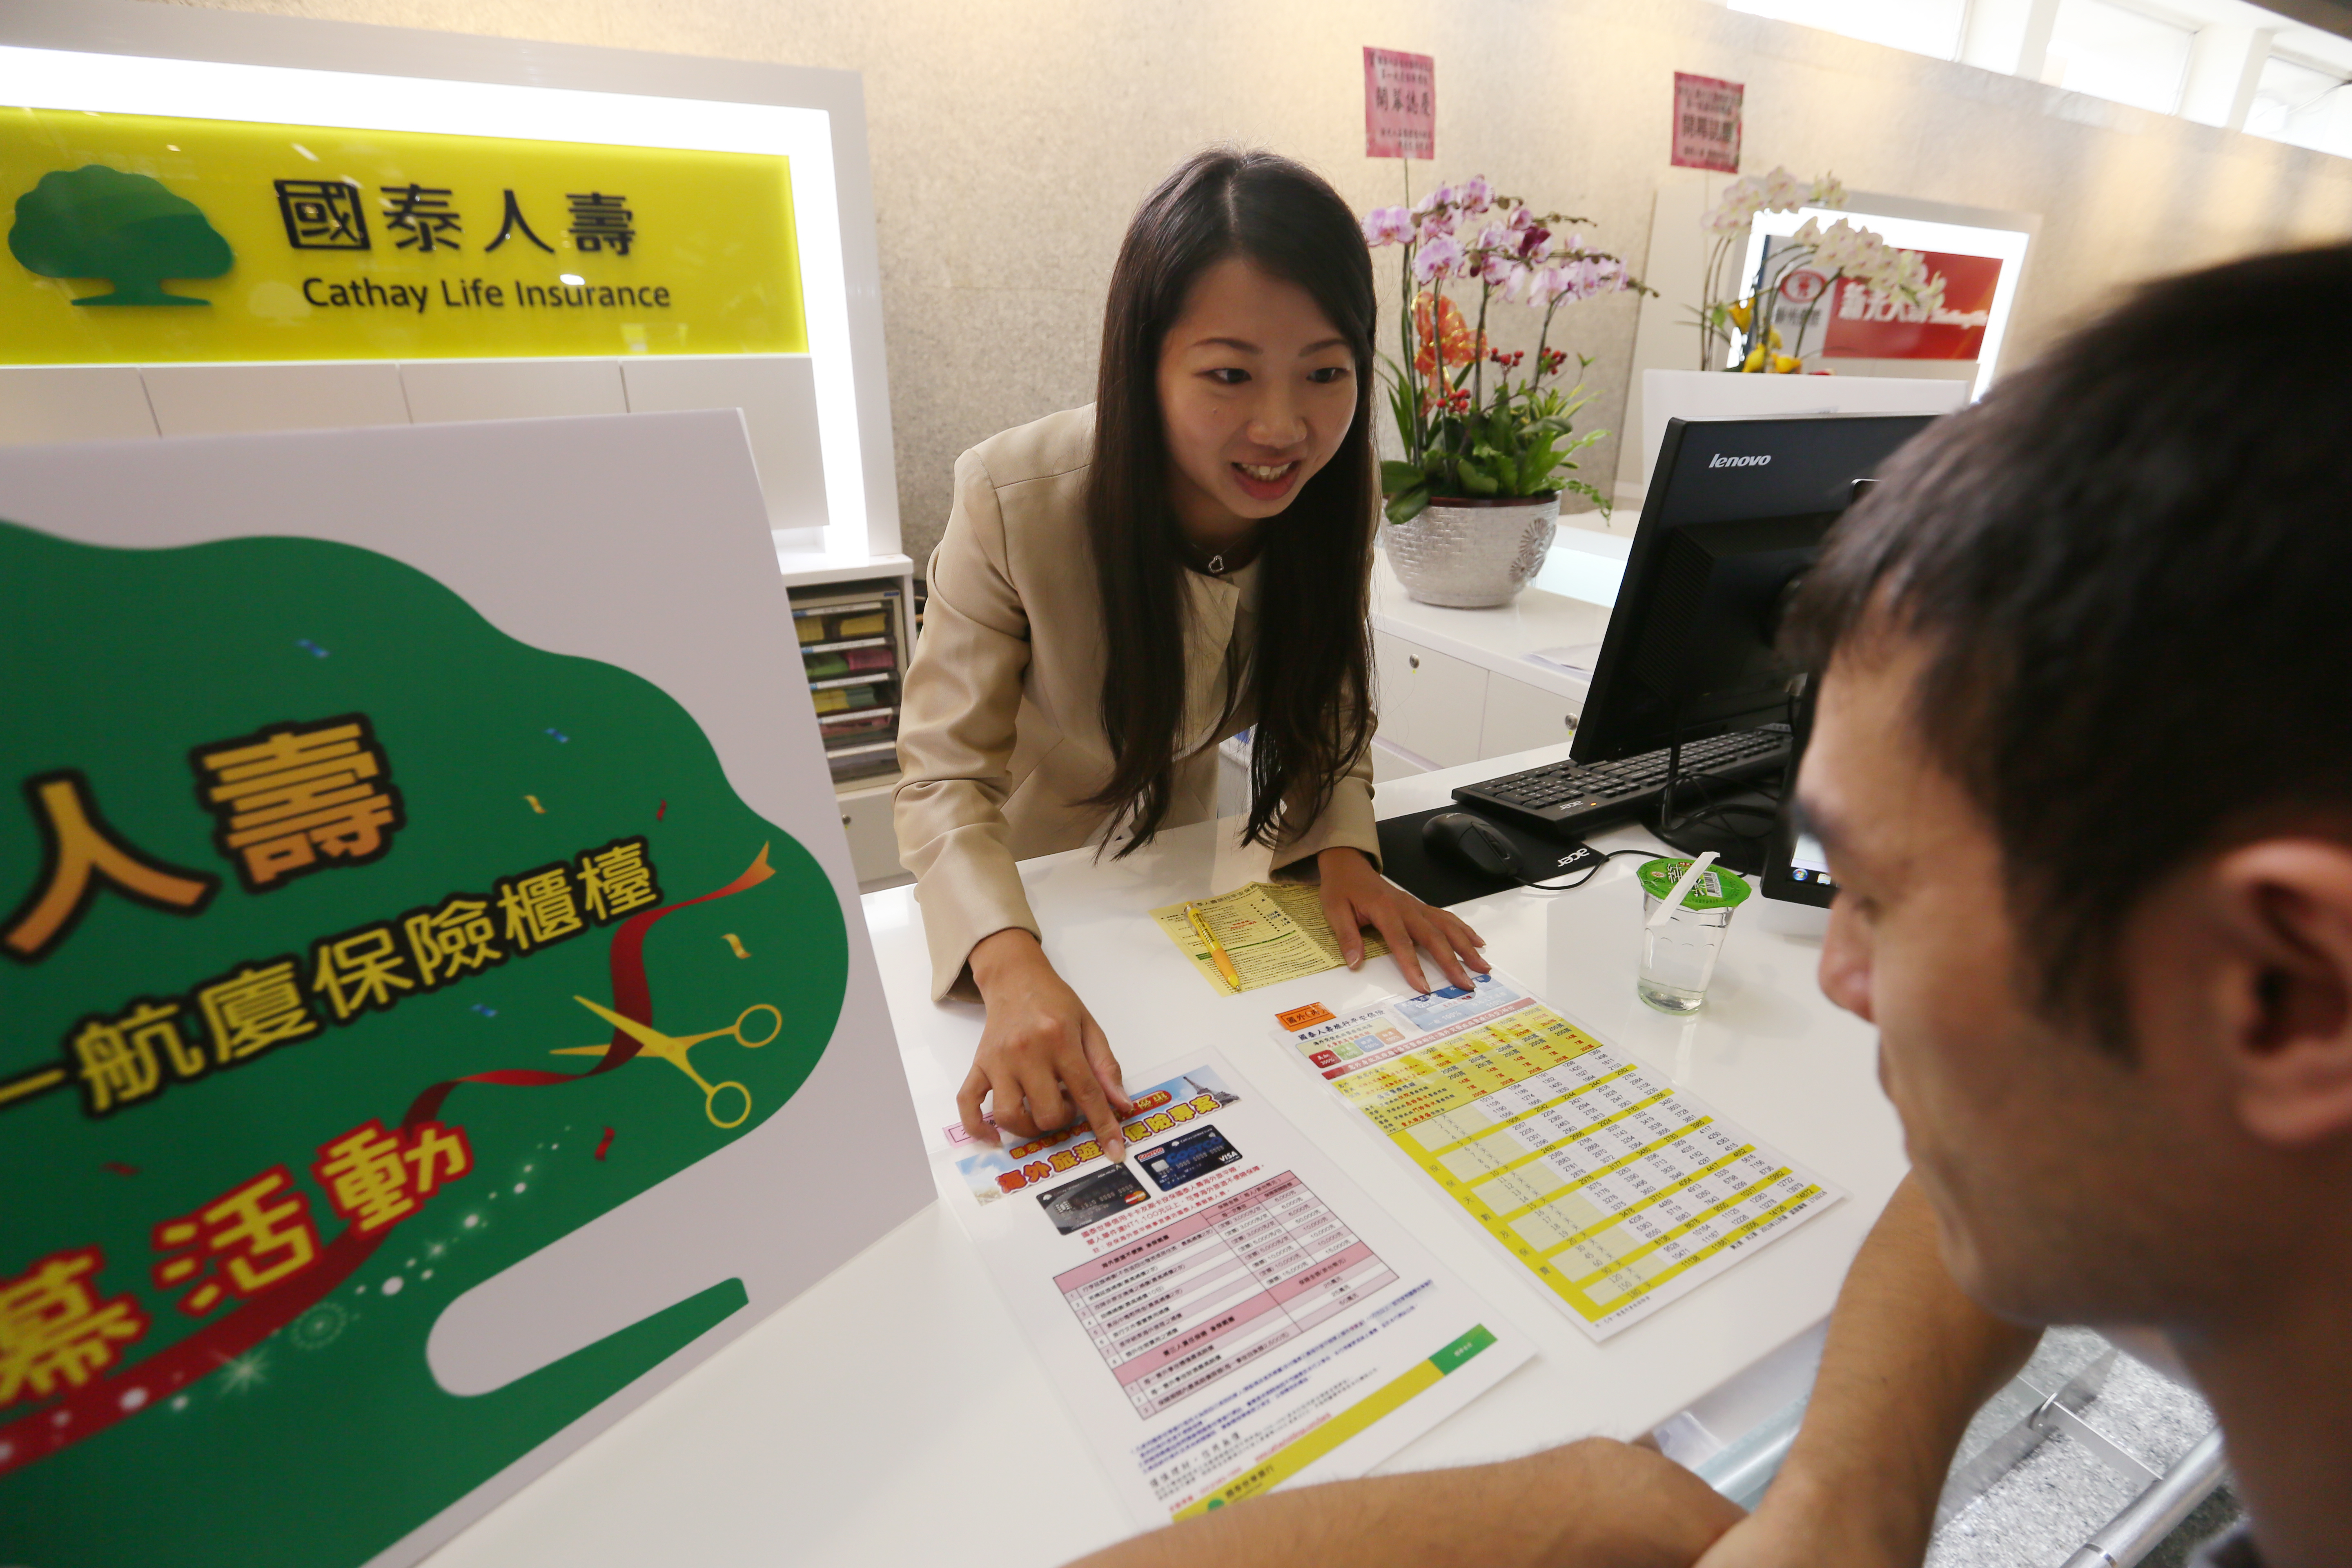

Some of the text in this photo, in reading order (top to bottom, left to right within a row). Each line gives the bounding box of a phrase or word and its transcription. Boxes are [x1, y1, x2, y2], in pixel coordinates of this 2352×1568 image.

[274, 179, 635, 256] 國泰人壽
[303, 277, 670, 313] Cathay Life Insurance
[1709, 454, 1771, 468] lenovo
[1559, 801, 1584, 810] acer
[2, 721, 398, 958] 人壽
[1558, 848, 1590, 867] acer
[1414, 999, 1437, 1009] 125%
[1440, 1010, 1463, 1020] 100%
[1297, 1007, 1386, 1042] 國泰人壽旅行平安保險
[1440, 1065, 1460, 1075] 200萬
[1467, 1054, 1487, 1064] 200萬
[1494, 1043, 1514, 1053] 200萬
[1521, 1033, 1539, 1042] 200萬
[1546, 1022, 1566, 1032] 200萬
[1479, 1095, 1494, 1103] 1013
[1507, 1083, 1522, 1091] 1084
[1485, 1100, 1501, 1108] 1108
[1514, 1088, 1529, 1096] 1186
[1568, 1065, 1583, 1073] 1420
[1505, 1067, 1630, 1125] 1908 2042 2244 2447 2582
[1511, 1072, 1637, 1130] 2057 2204 2421 2638 2783
[1539, 1092, 1666, 1154] 2493 2666 2924 3183 3356
[996, 1094, 1221, 1193] 海外旅遊便險專案
[1138, 1147, 1163, 1160] COSTCO
[1166, 1136, 1223, 1163] COSTCO
[1218, 1151, 1238, 1162] VISA
[1577, 1120, 1706, 1185] 2976 3177 3480 3783 3985
[1618, 1148, 1748, 1218] 3478 3711 4064 4417 4652
